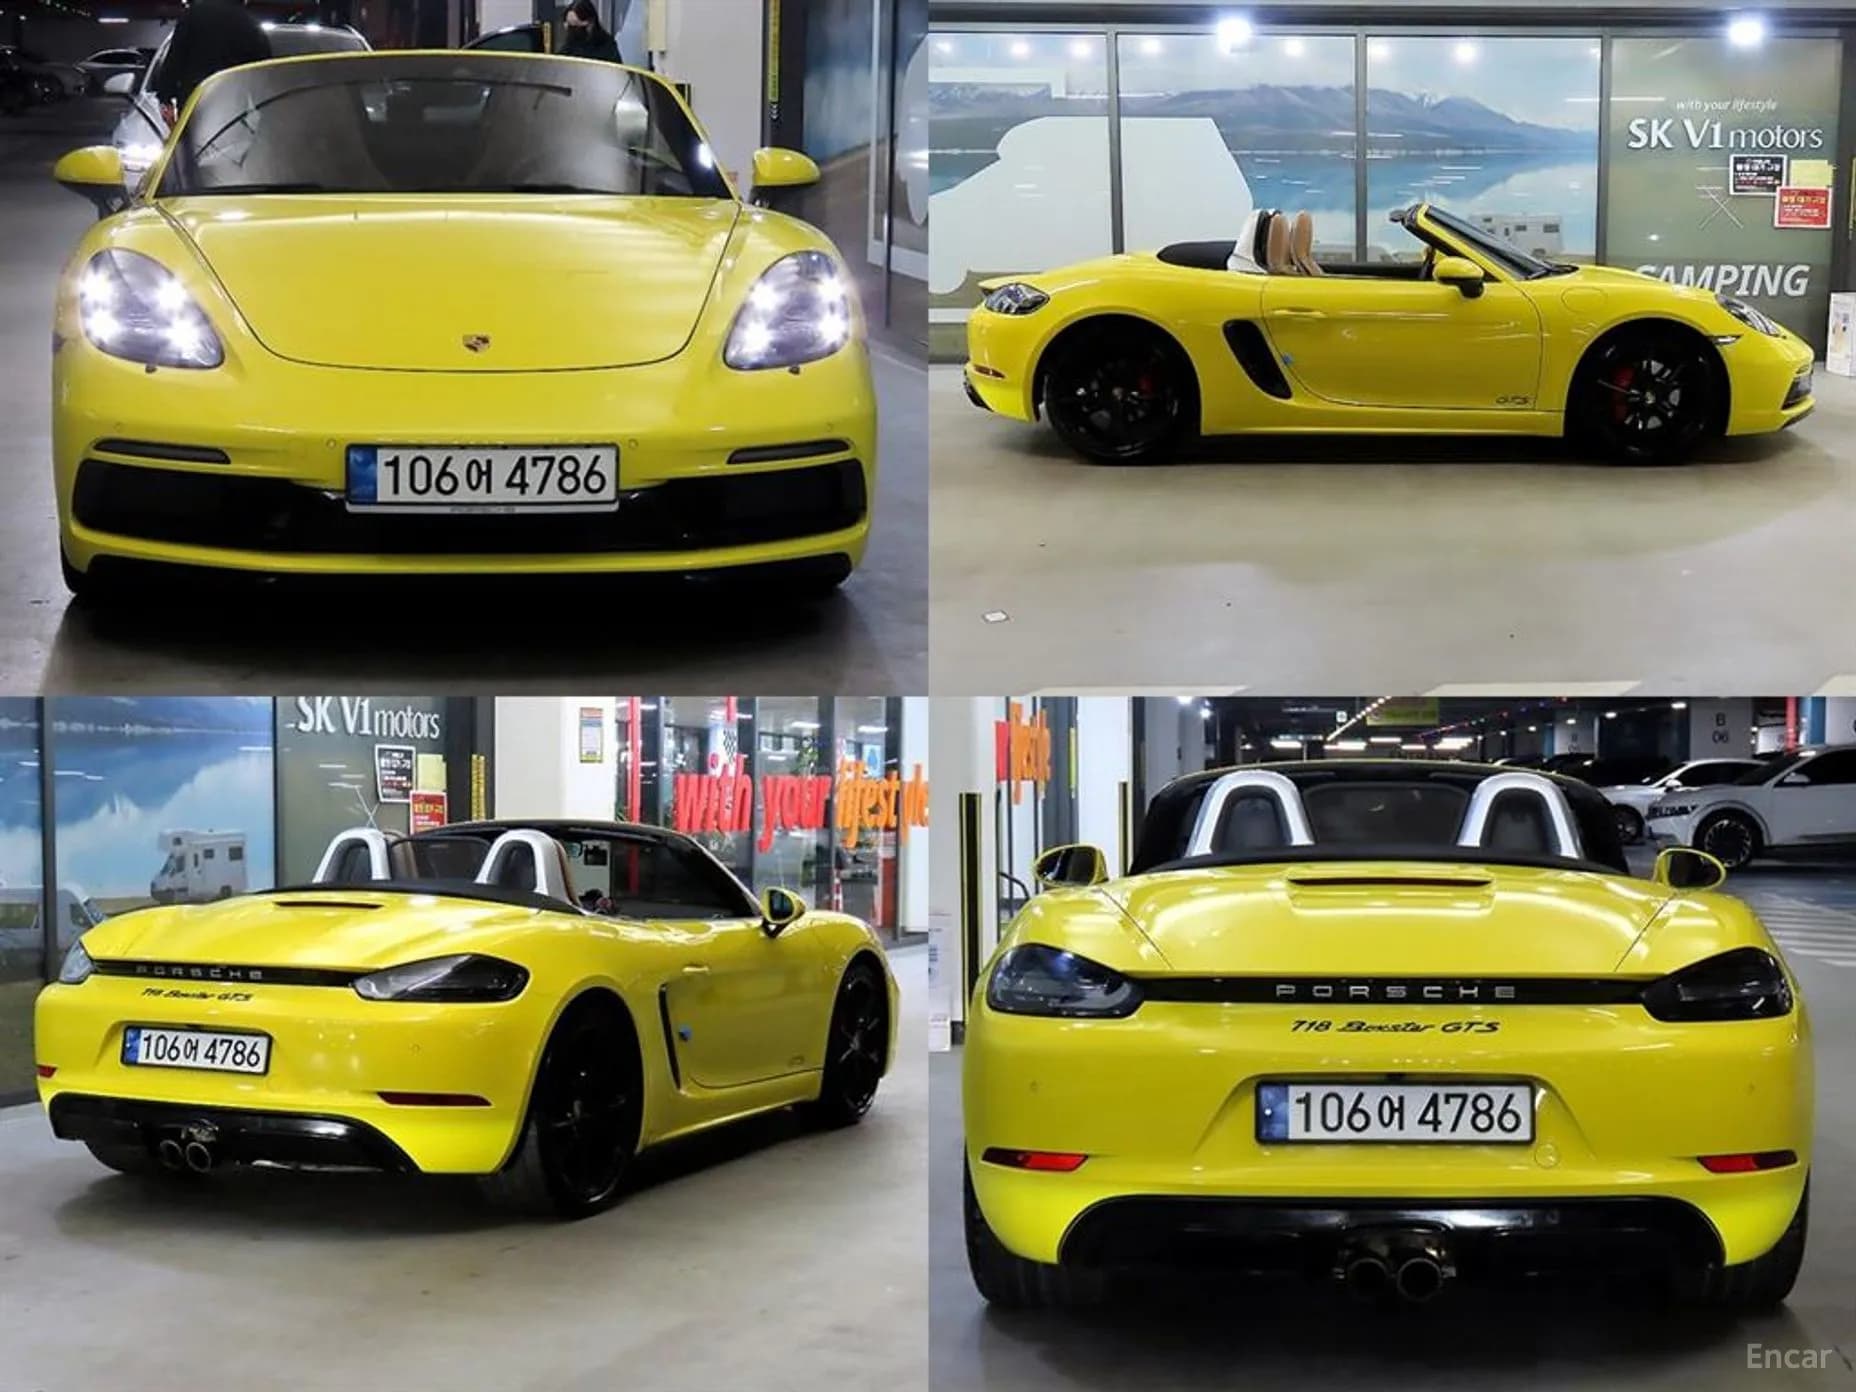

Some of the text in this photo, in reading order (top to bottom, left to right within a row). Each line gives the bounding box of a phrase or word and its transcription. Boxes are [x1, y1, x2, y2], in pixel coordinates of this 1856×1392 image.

[1676, 98, 1778, 113] with your lifestyle
[1627, 118, 1824, 149] SK V1 motors
[384, 455, 607, 496] 106어 4786
[298, 696, 441, 740] SK V1 motors
[673, 752, 752, 832] with
[757, 774, 833, 854] your
[136, 965, 263, 980] PORSCHE
[1275, 984, 1516, 998] PORSCHE
[1291, 1020, 1500, 1033] 718 Boxster GTS
[142, 1033, 261, 1068] 106어 4786
[1295, 1092, 1522, 1133] 106어 4786
